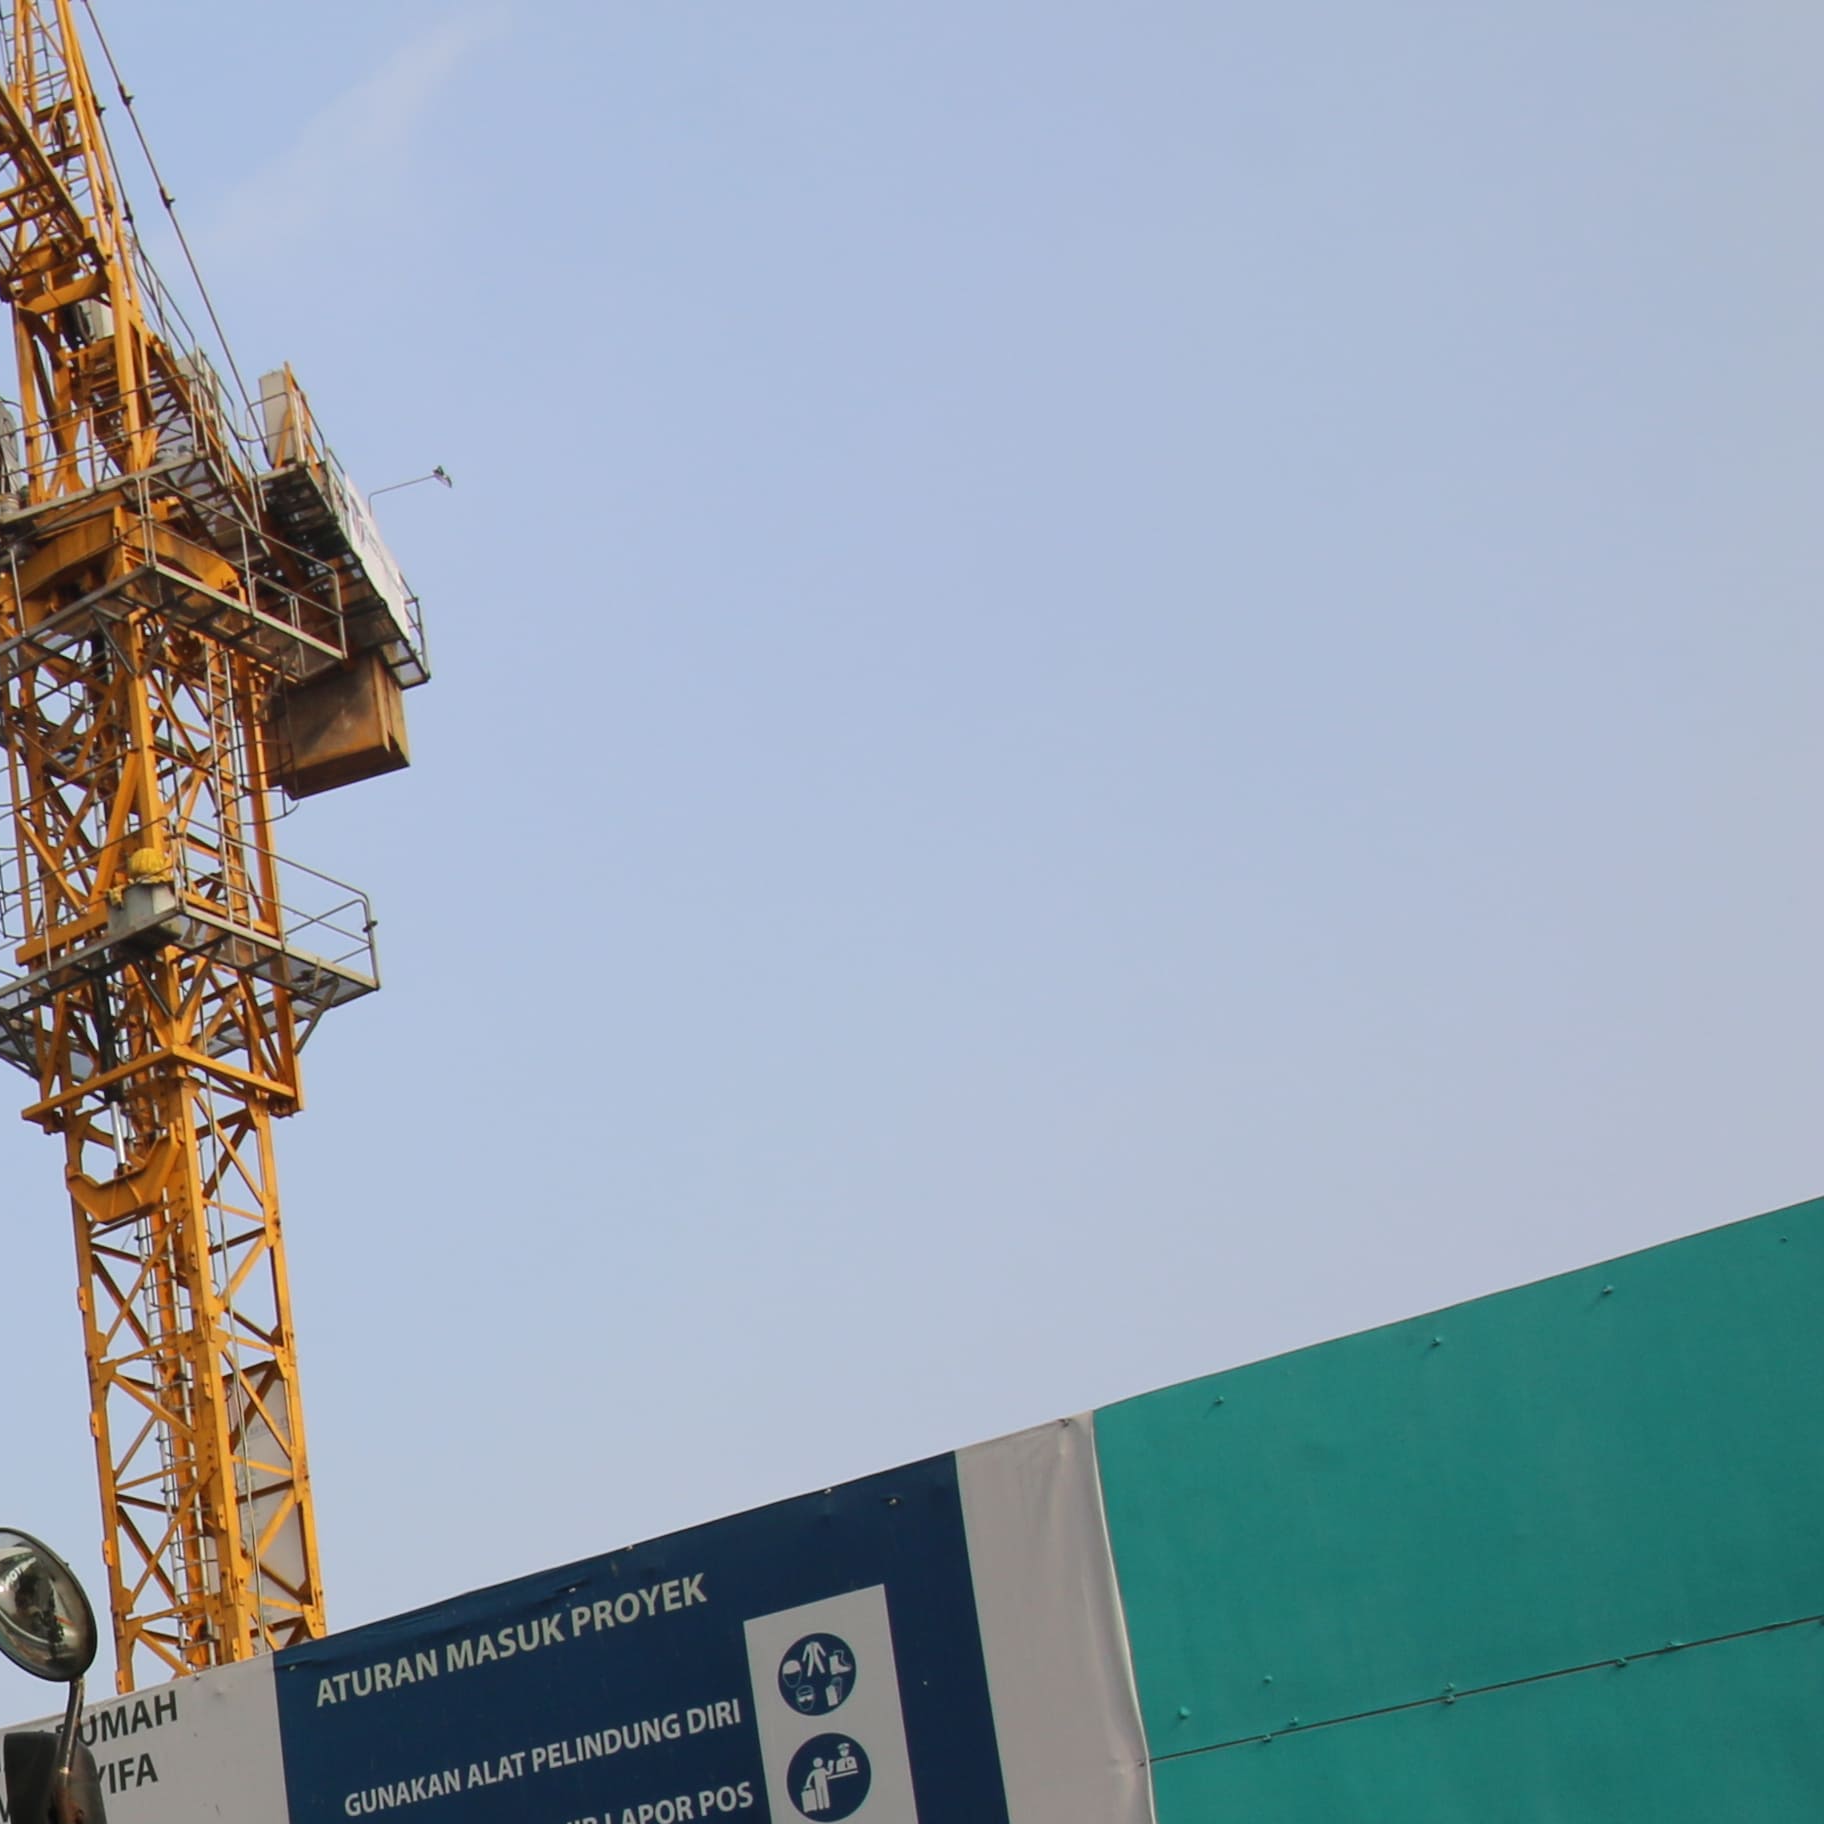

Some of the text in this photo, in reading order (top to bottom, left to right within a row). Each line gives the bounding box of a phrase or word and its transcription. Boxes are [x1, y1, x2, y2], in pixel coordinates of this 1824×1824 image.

[317, 1573, 707, 1707] ATURAN MASUK PROYEK
[56, 1690, 177, 1750] UMAH
[345, 1699, 740, 1816] GUNAKAN ALAT PELINDUNG DIRI
[699, 1782, 753, 1816] POS
